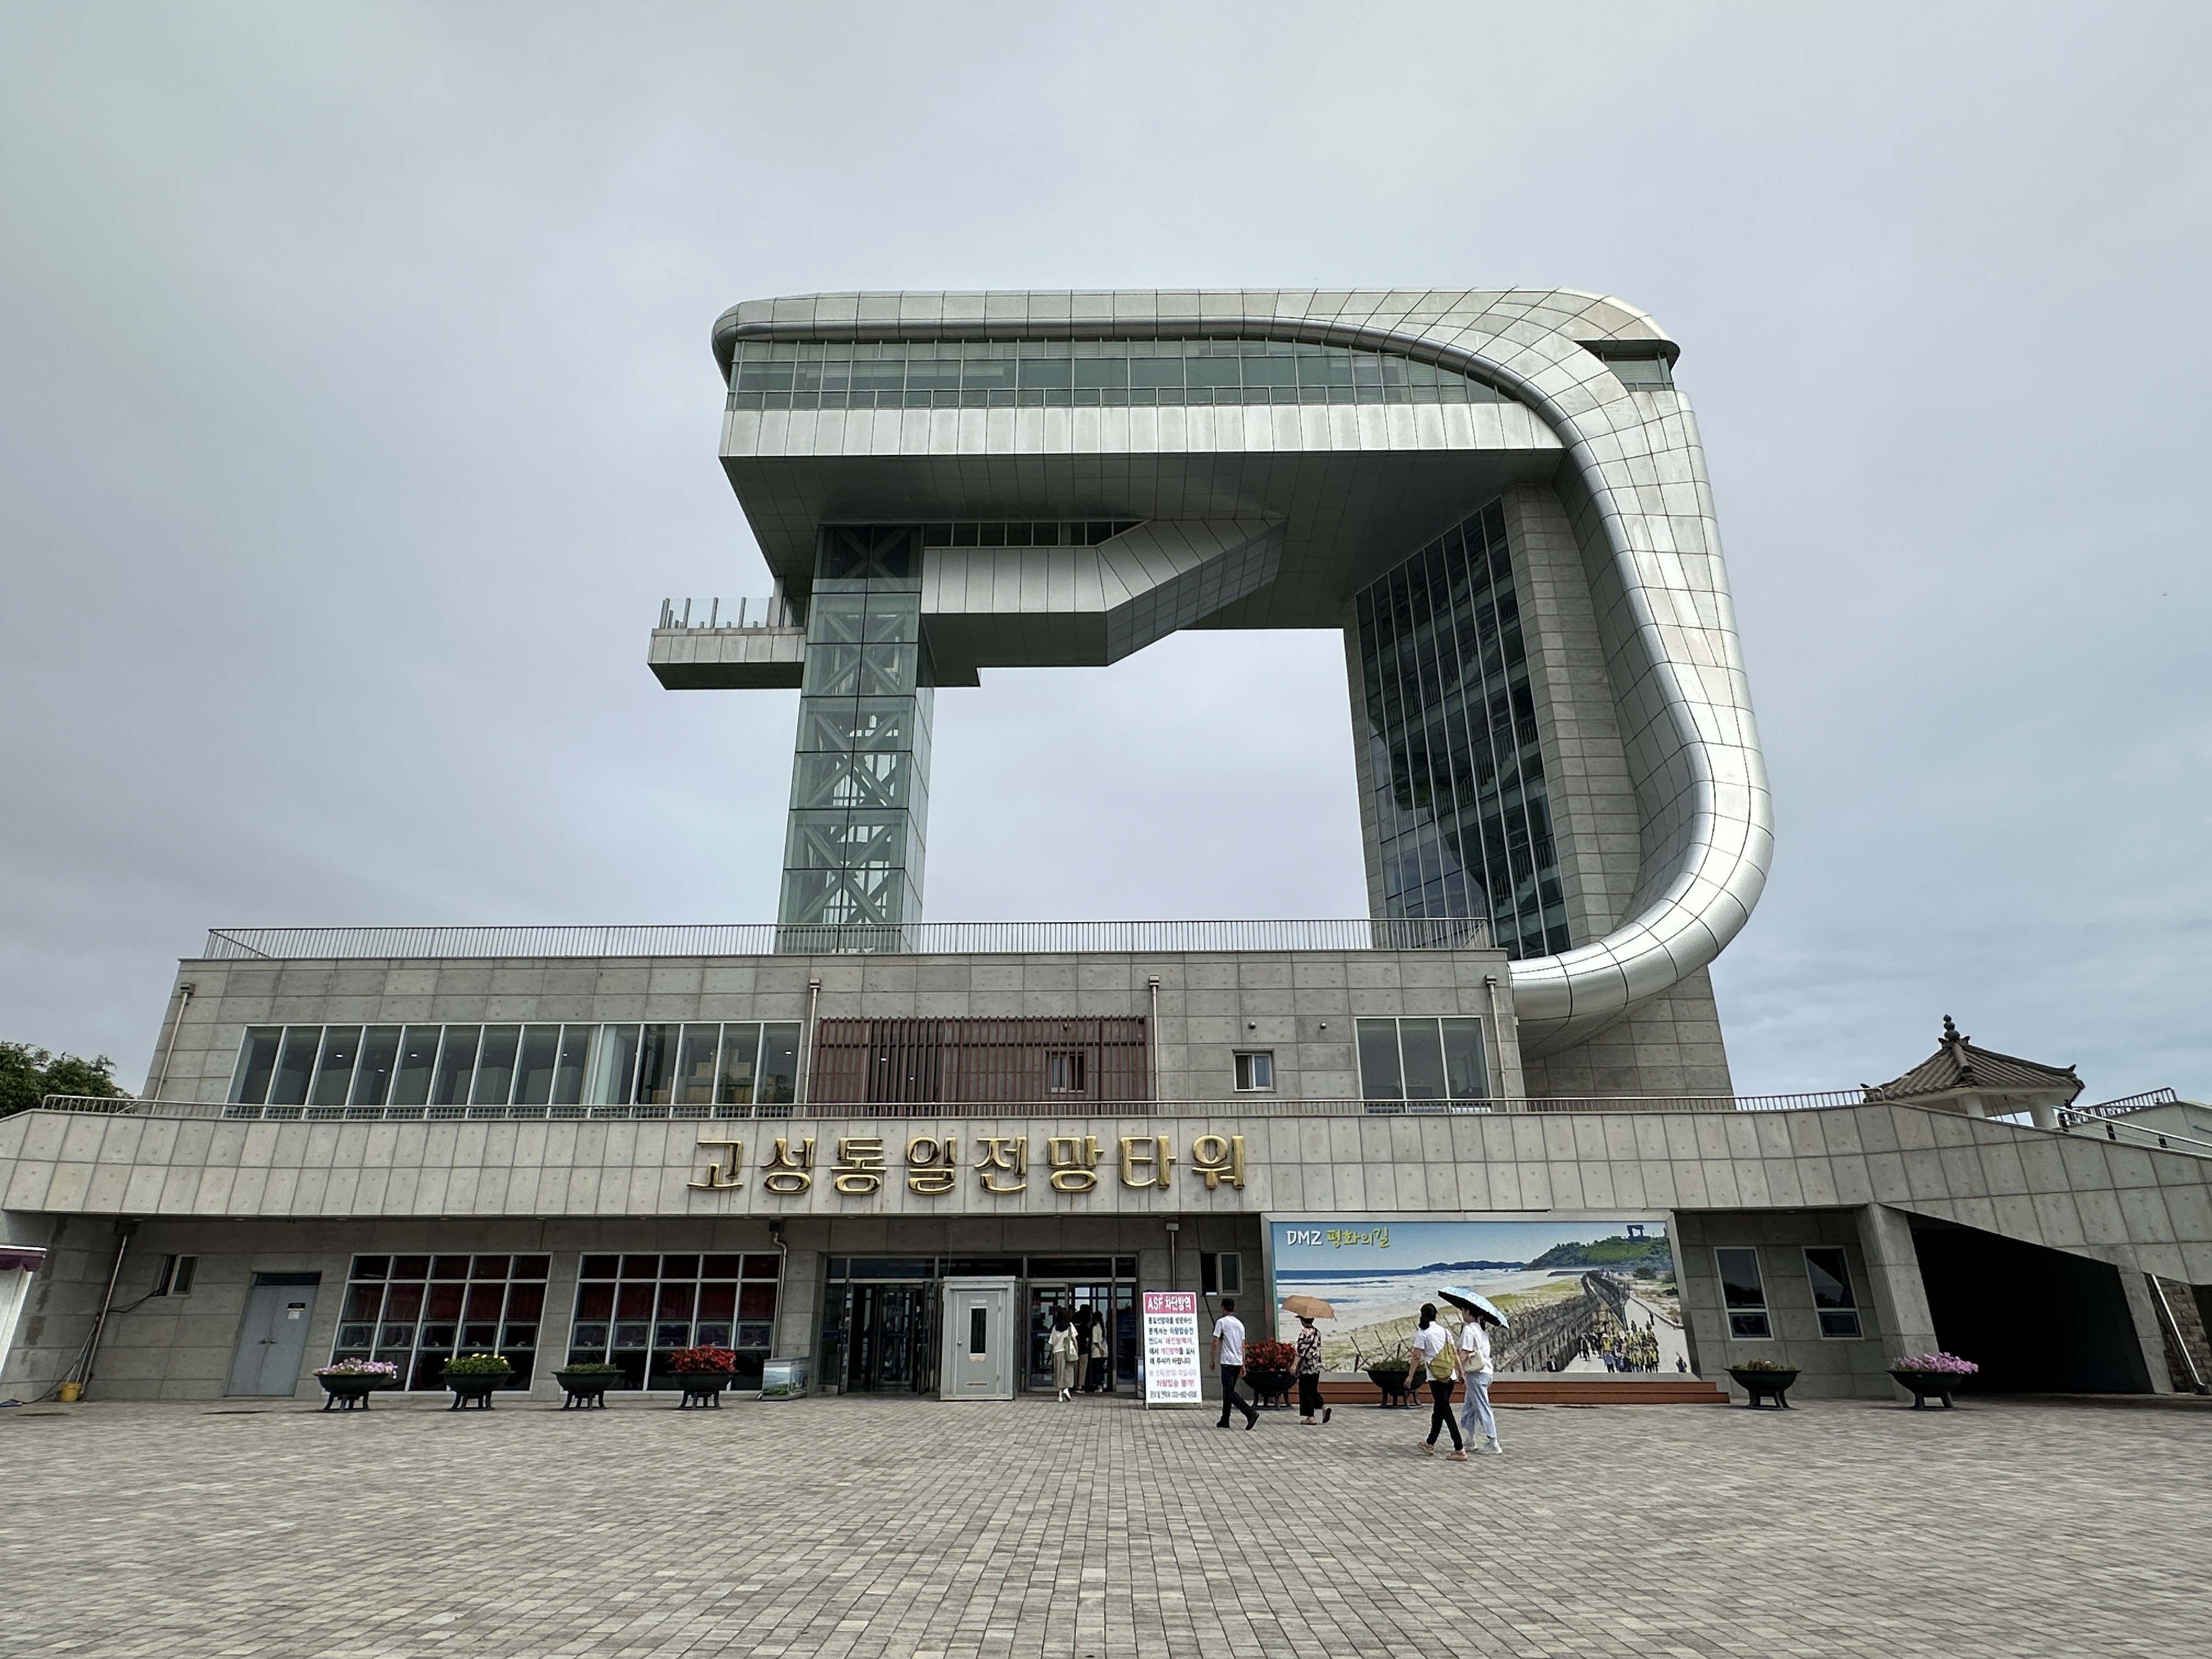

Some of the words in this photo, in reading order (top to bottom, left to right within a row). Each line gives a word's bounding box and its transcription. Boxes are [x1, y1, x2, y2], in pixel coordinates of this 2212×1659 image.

[687, 1135, 1245, 1195] 고성통일전망타워
[1286, 1229, 1323, 1245] DMZ
[1148, 1296, 1163, 1311] ASF
[1165, 1295, 1192, 1311] 차단방역
